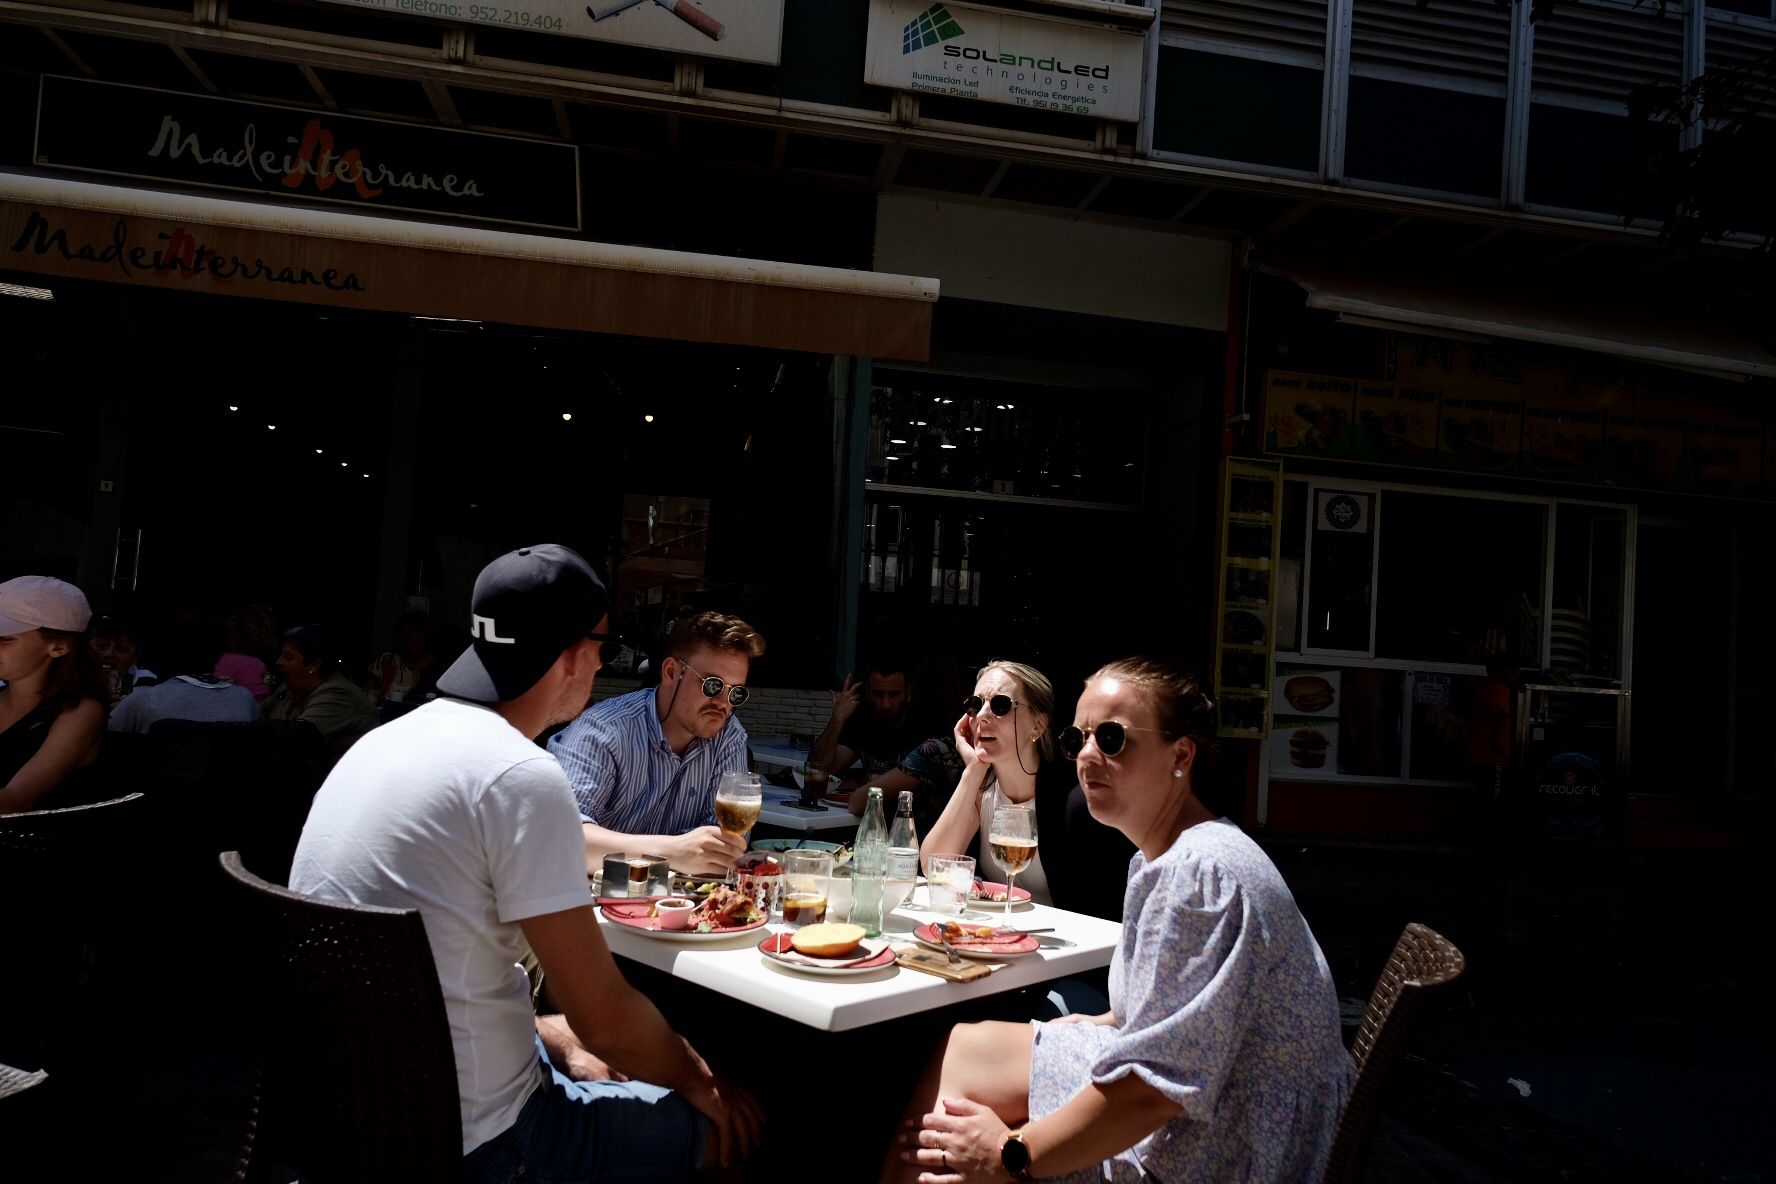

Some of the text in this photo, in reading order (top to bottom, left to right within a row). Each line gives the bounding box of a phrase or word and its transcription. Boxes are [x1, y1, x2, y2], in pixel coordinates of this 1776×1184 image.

[469, 4, 563, 31] 952.219.404
[943, 60, 1107, 93] technologies
[964, 78, 980, 88] Led
[911, 82, 947, 94] Primera
[1009, 85, 1049, 98] Eficiencia
